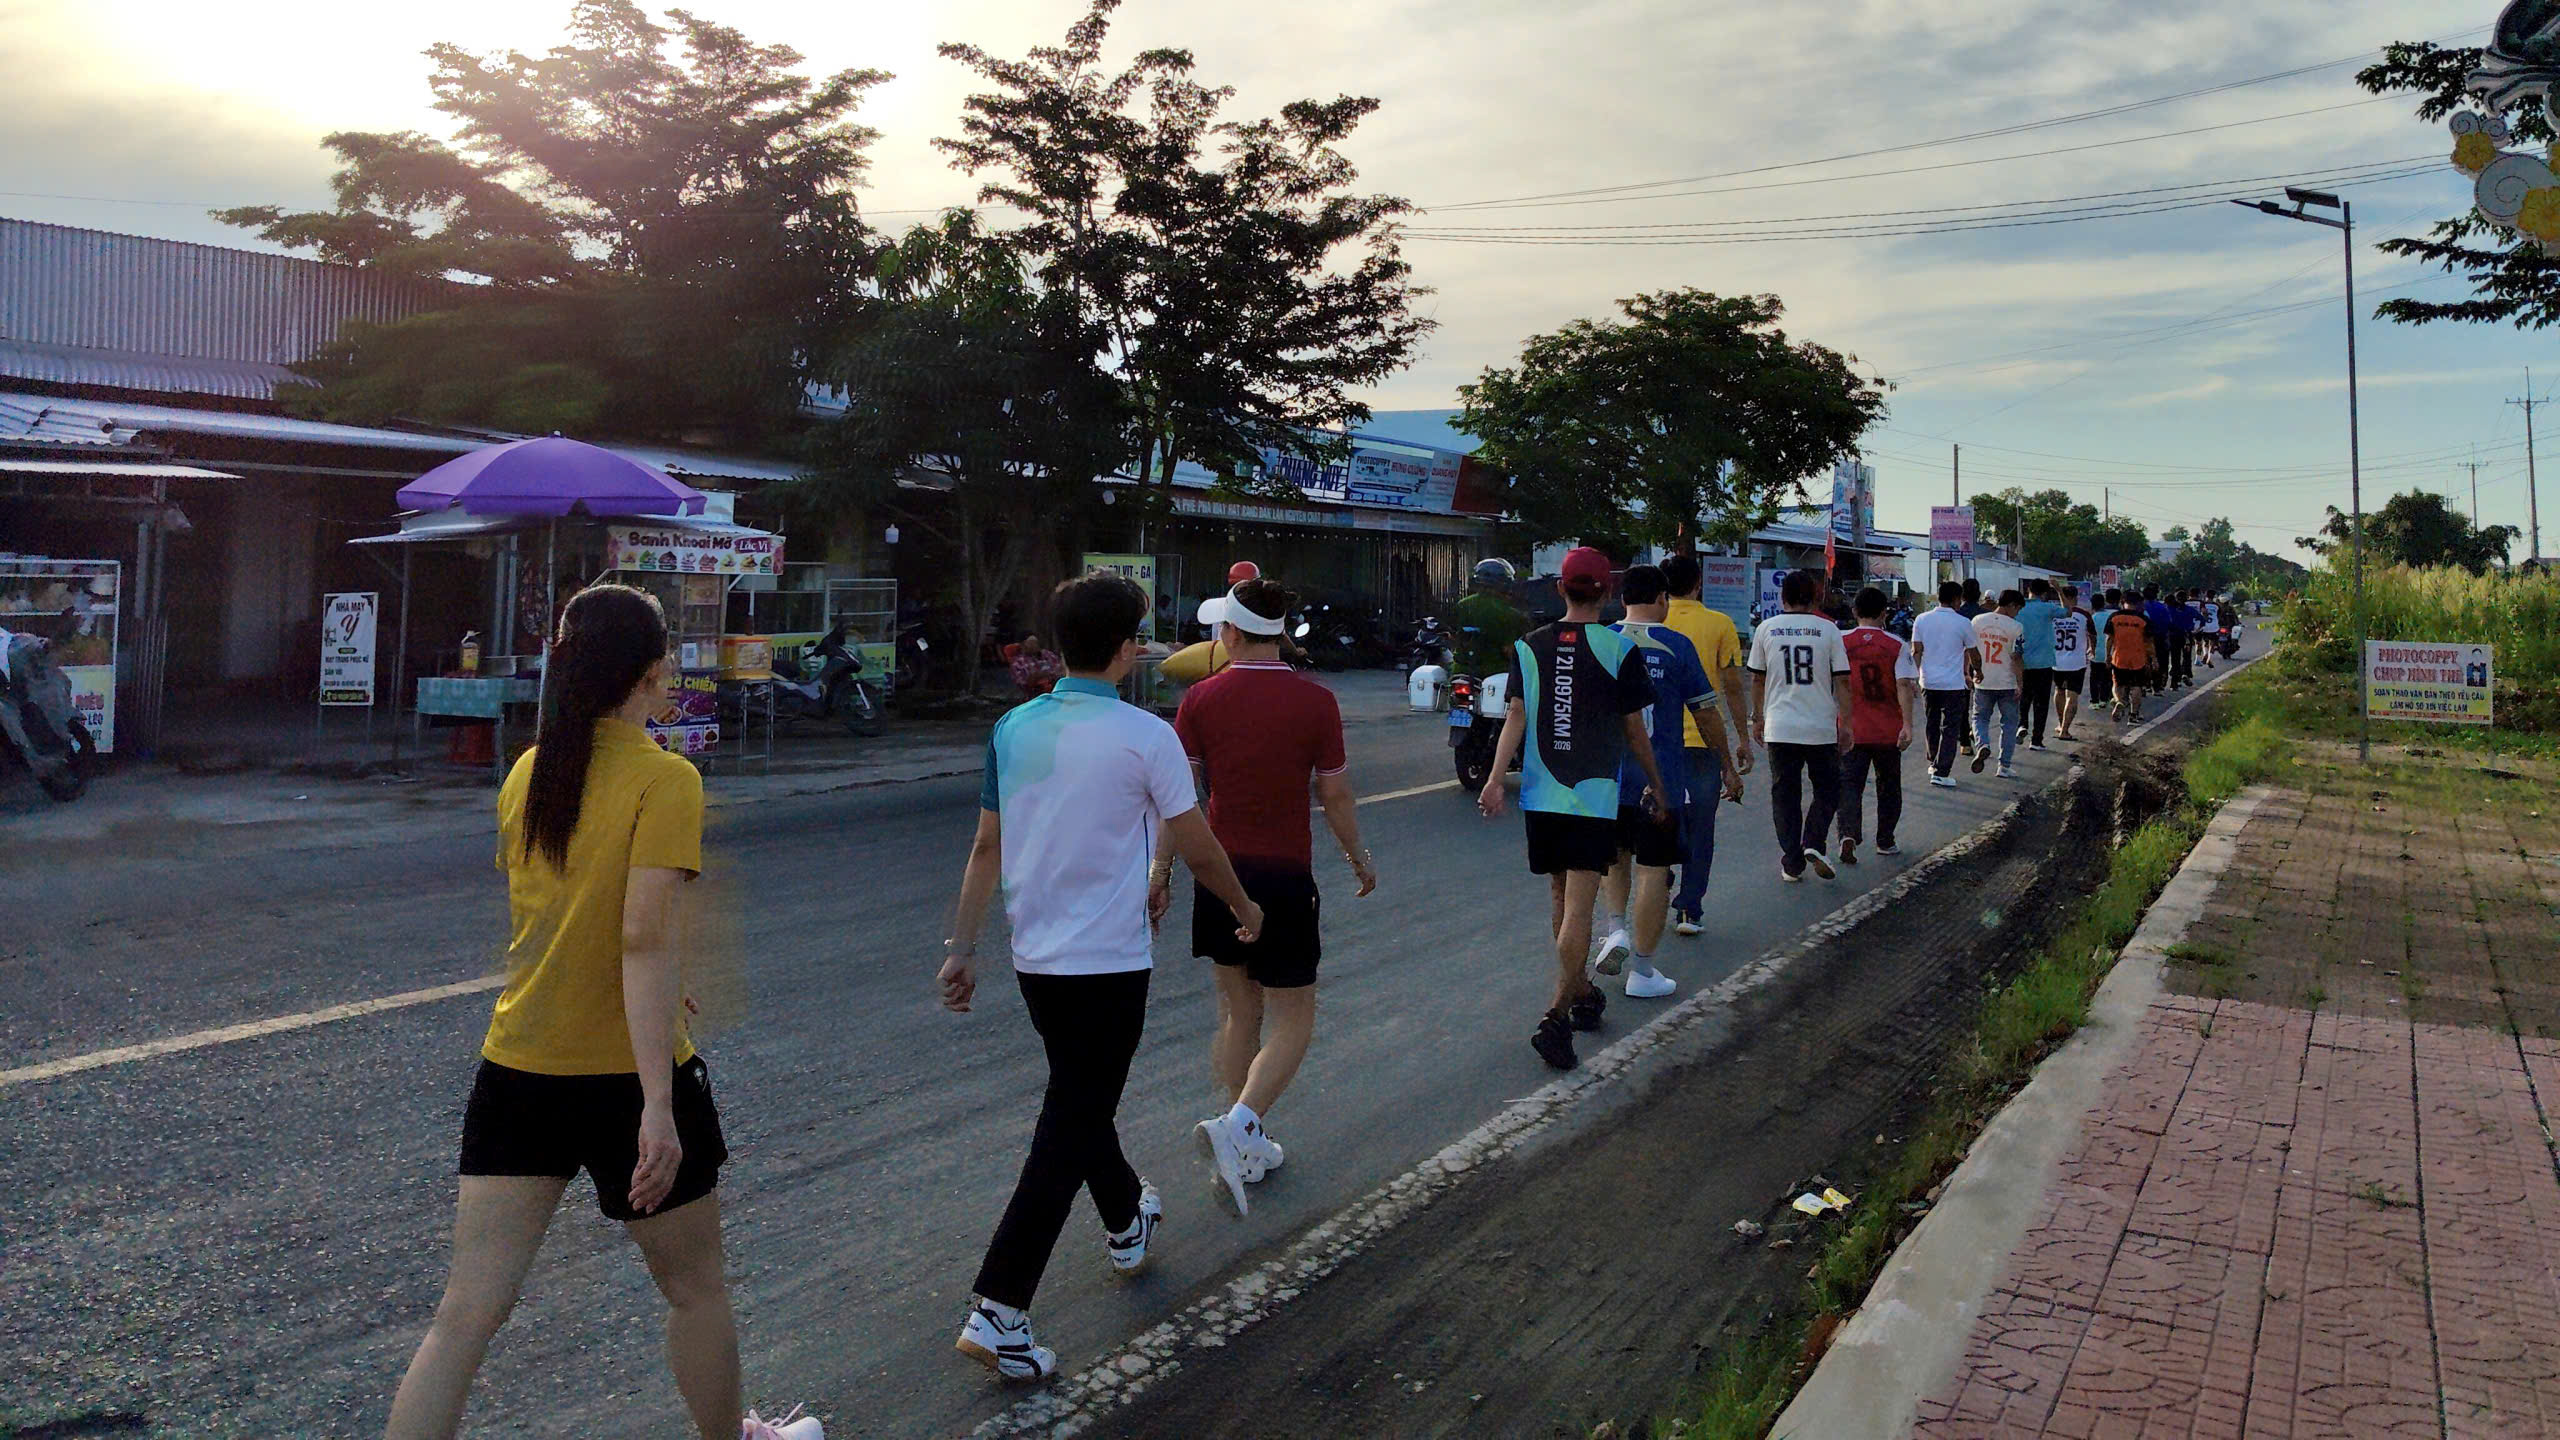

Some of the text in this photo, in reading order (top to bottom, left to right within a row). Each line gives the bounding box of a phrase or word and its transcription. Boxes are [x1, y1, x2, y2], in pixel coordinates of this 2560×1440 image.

[1984, 640, 2003, 664] 12
[2055, 629, 2077, 651] 35
[1779, 645, 1814, 686] 18
[1554, 656, 1574, 738] 21.0975KM
